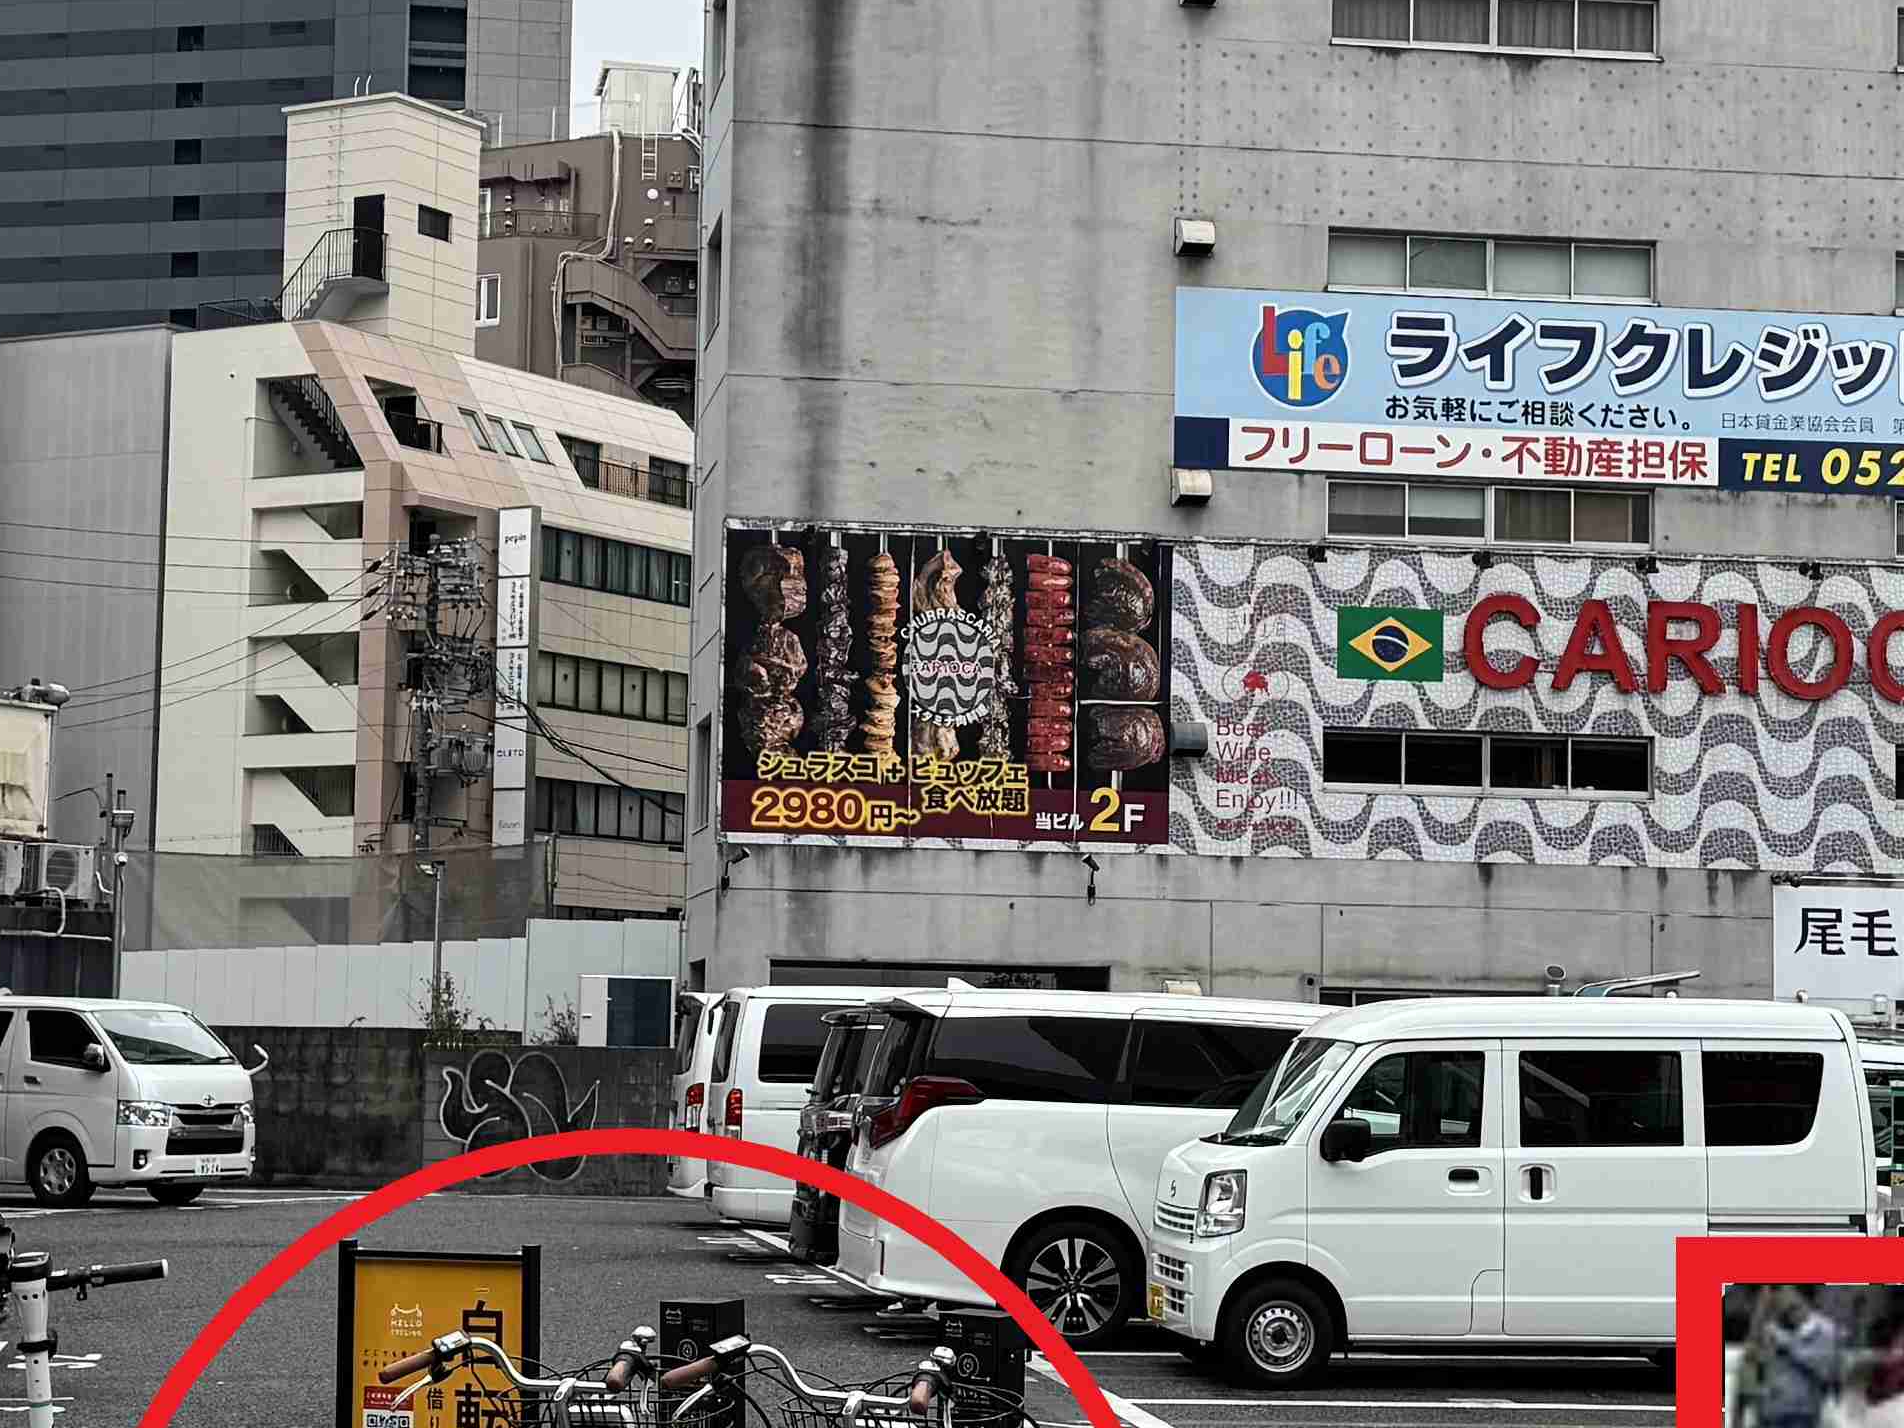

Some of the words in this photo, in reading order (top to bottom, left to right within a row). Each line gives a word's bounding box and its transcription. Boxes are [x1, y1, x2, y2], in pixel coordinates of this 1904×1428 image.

[1385, 395, 1693, 431] お気軽にご相談ください。
[1241, 425, 1709, 481] フリーローン・不動産担保
[1742, 452, 1802, 482] TEL
[923, 784, 1029, 814] 食べ放題
